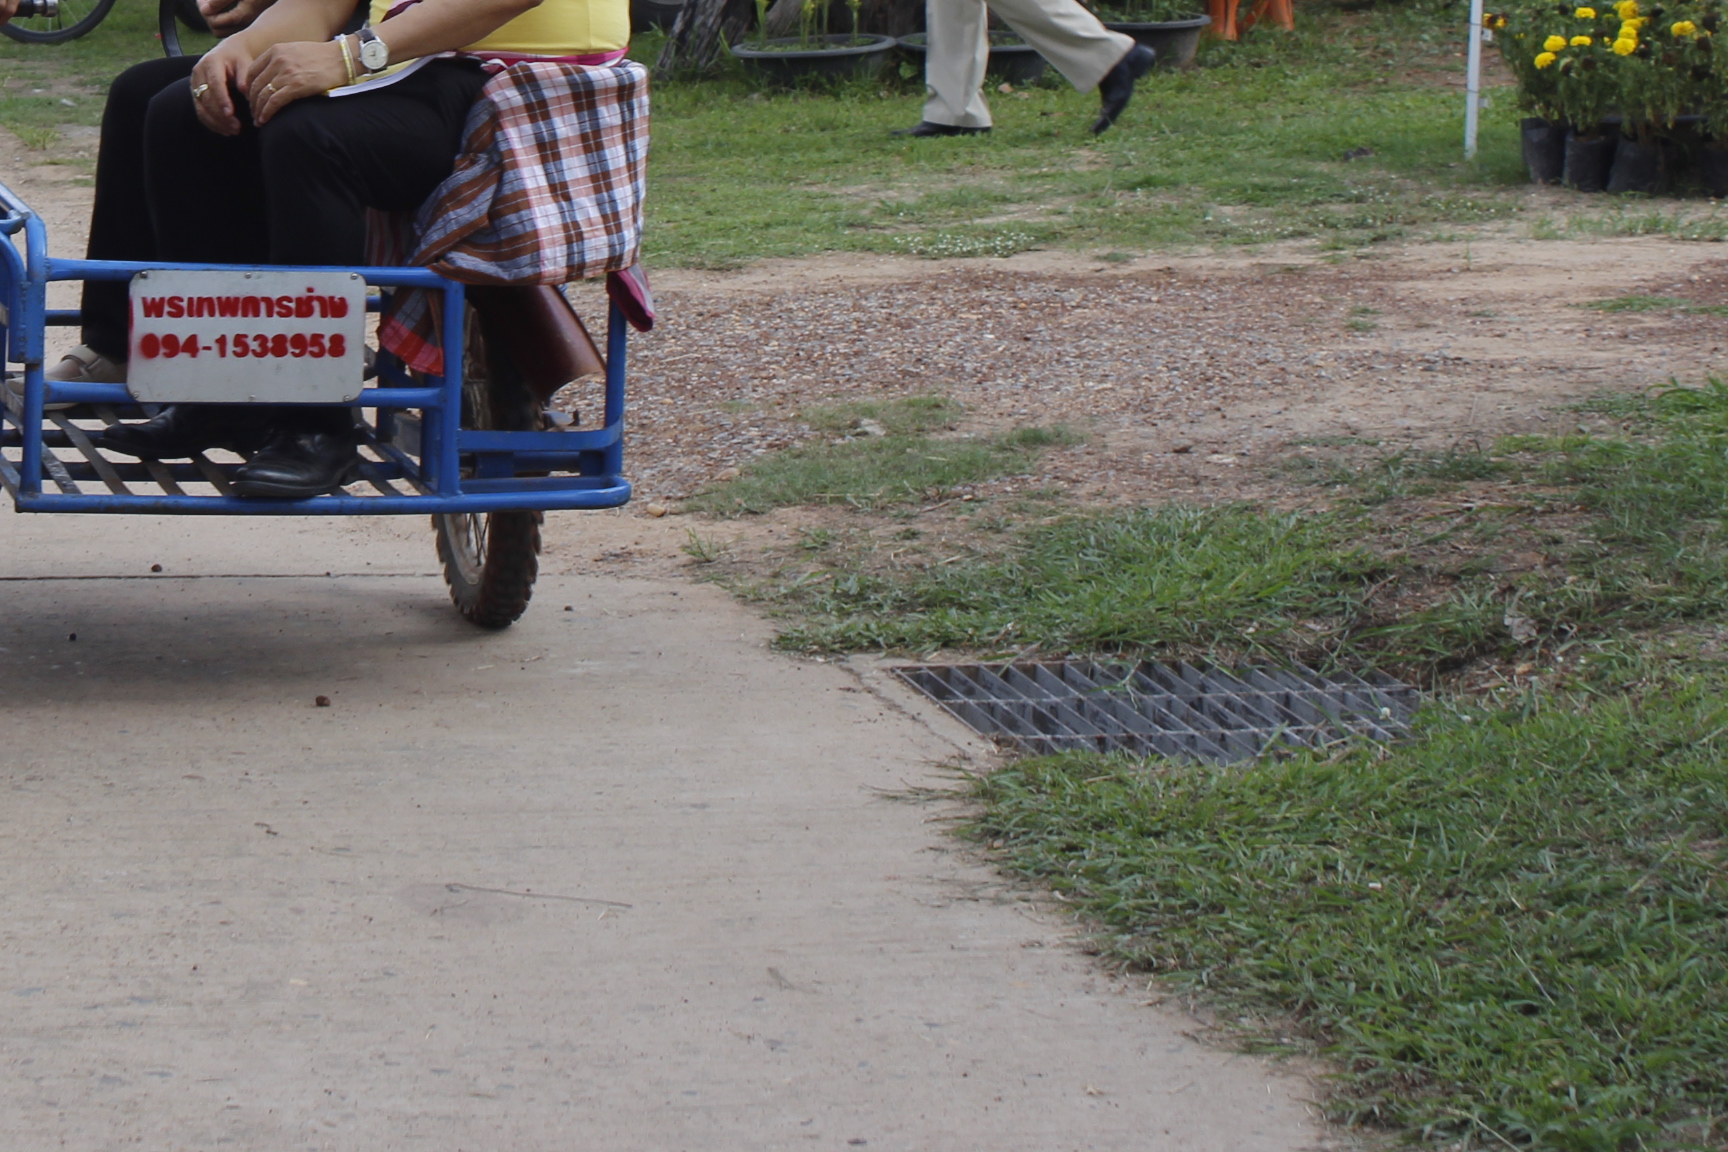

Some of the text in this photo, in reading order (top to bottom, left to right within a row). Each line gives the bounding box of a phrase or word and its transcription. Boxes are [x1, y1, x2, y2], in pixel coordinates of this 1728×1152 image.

[141, 287, 350, 318] พรเทพการช่าง
[139, 332, 346, 359] 094-1538958
